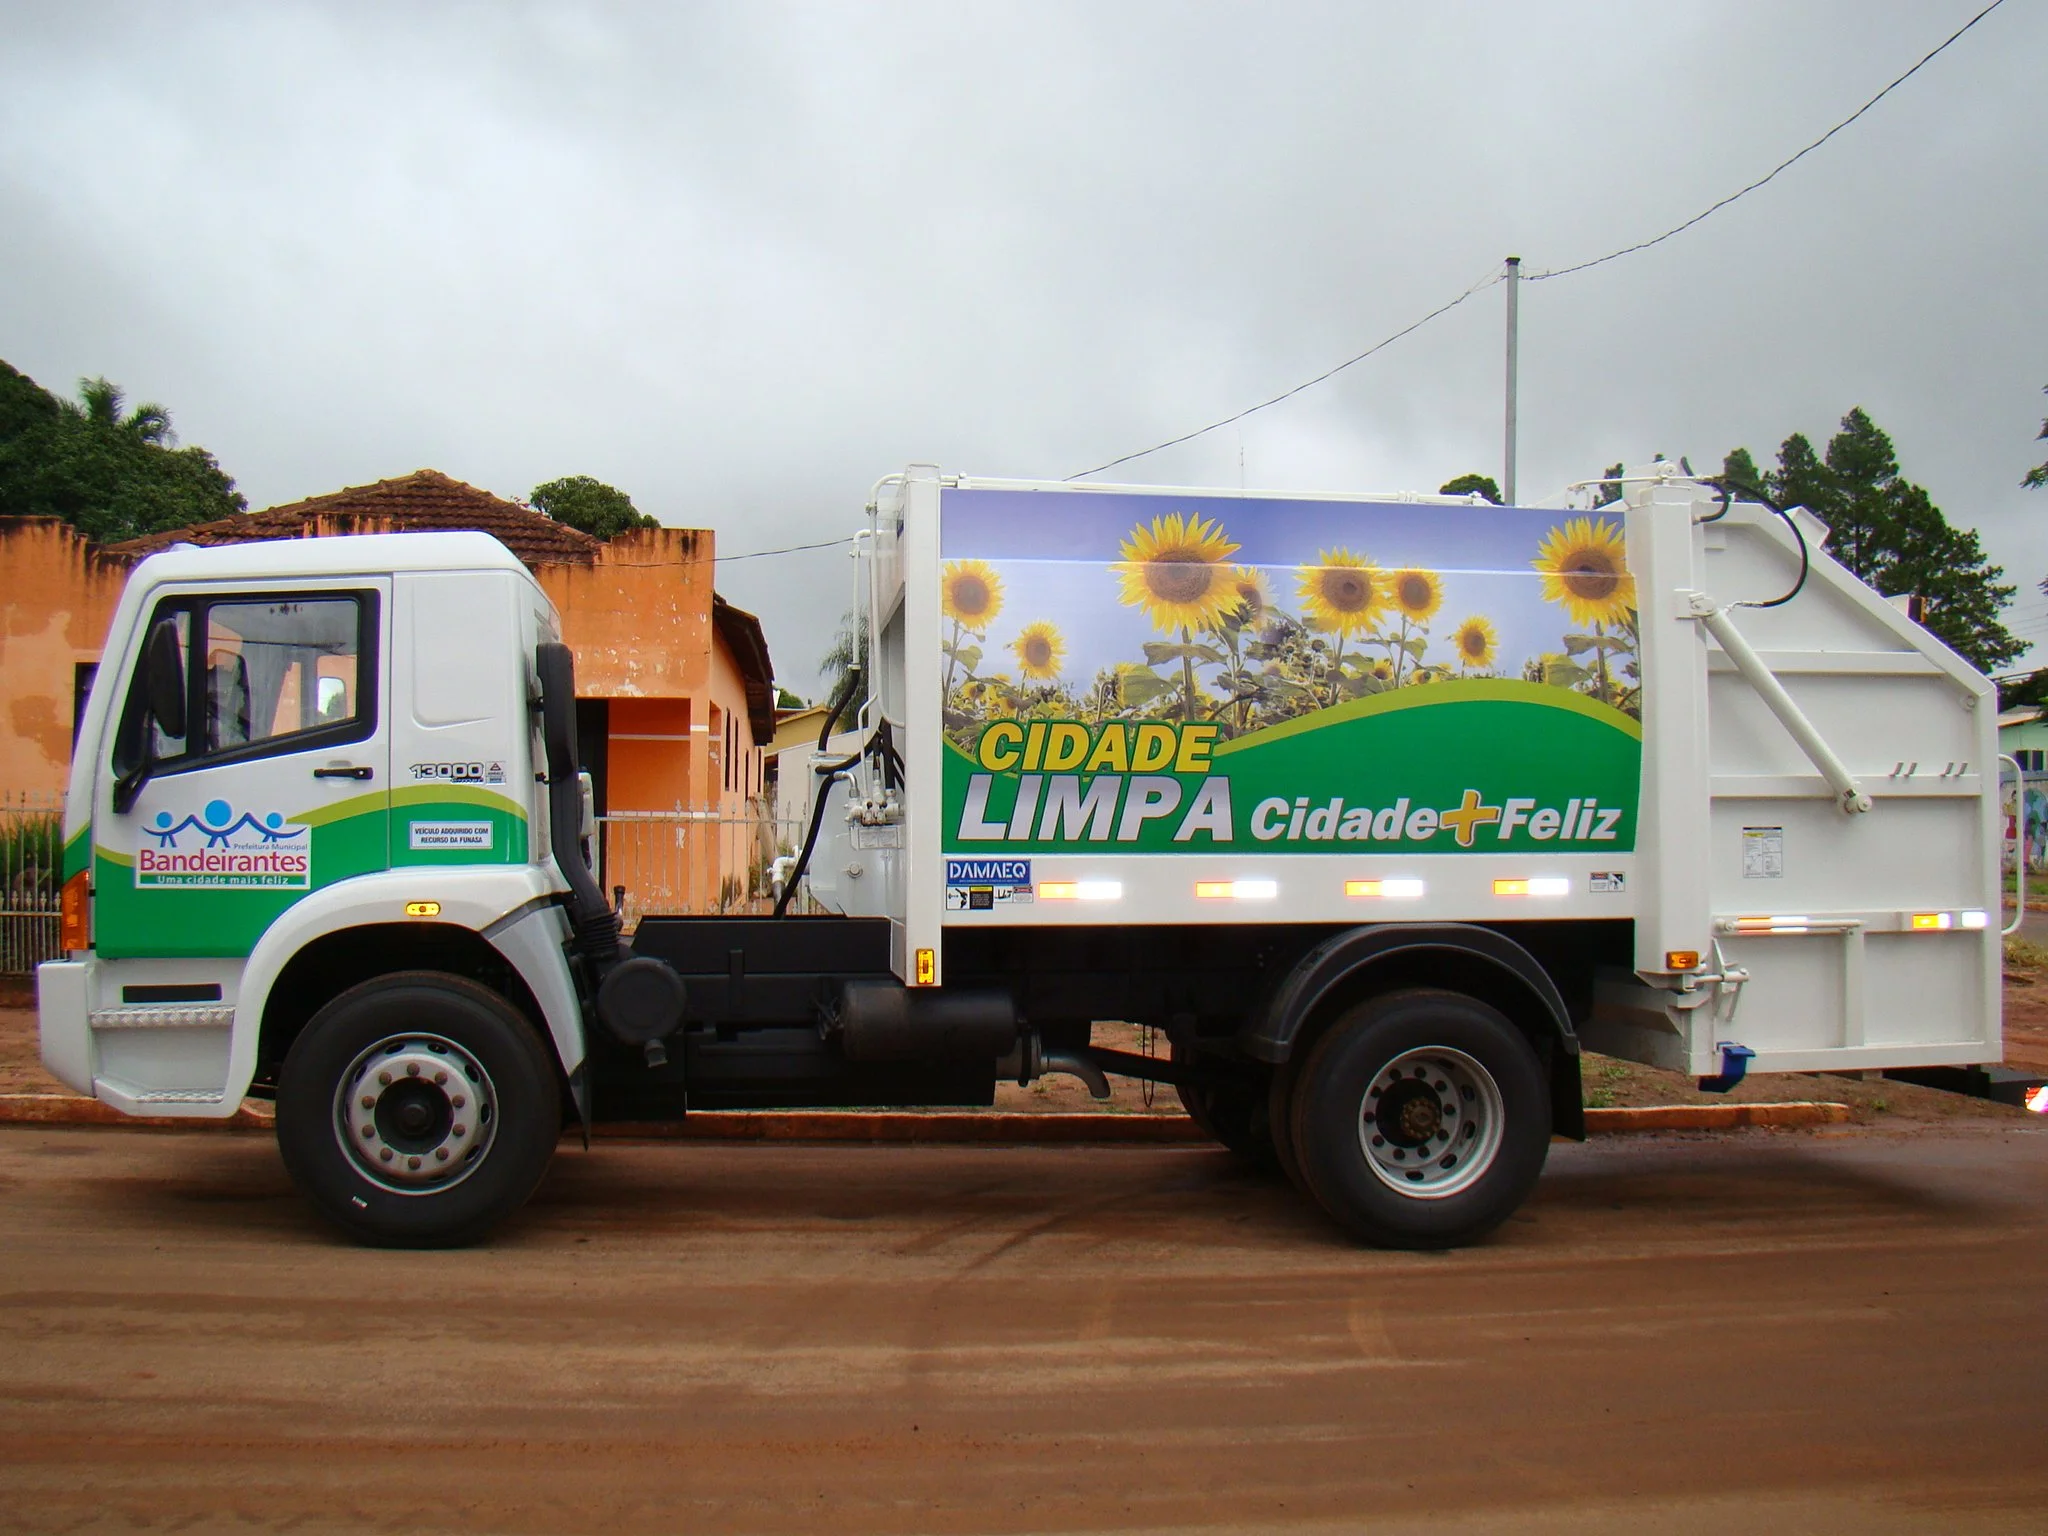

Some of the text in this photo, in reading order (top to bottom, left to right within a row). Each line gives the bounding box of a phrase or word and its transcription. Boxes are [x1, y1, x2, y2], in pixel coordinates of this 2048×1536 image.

[979, 722, 1219, 772] CIDADE
[409, 762, 484, 779] 13000
[956, 773, 1234, 841] LIMPA
[474, 827, 489, 835] COM
[271, 843, 308, 852] Municipal
[421, 836, 483, 844] RECURSO DA FUNASA
[140, 848, 307, 872] Bandeirantes
[949, 862, 1026, 878] DAMAEQ
[157, 875, 289, 885] Uma cidade mais feliz
